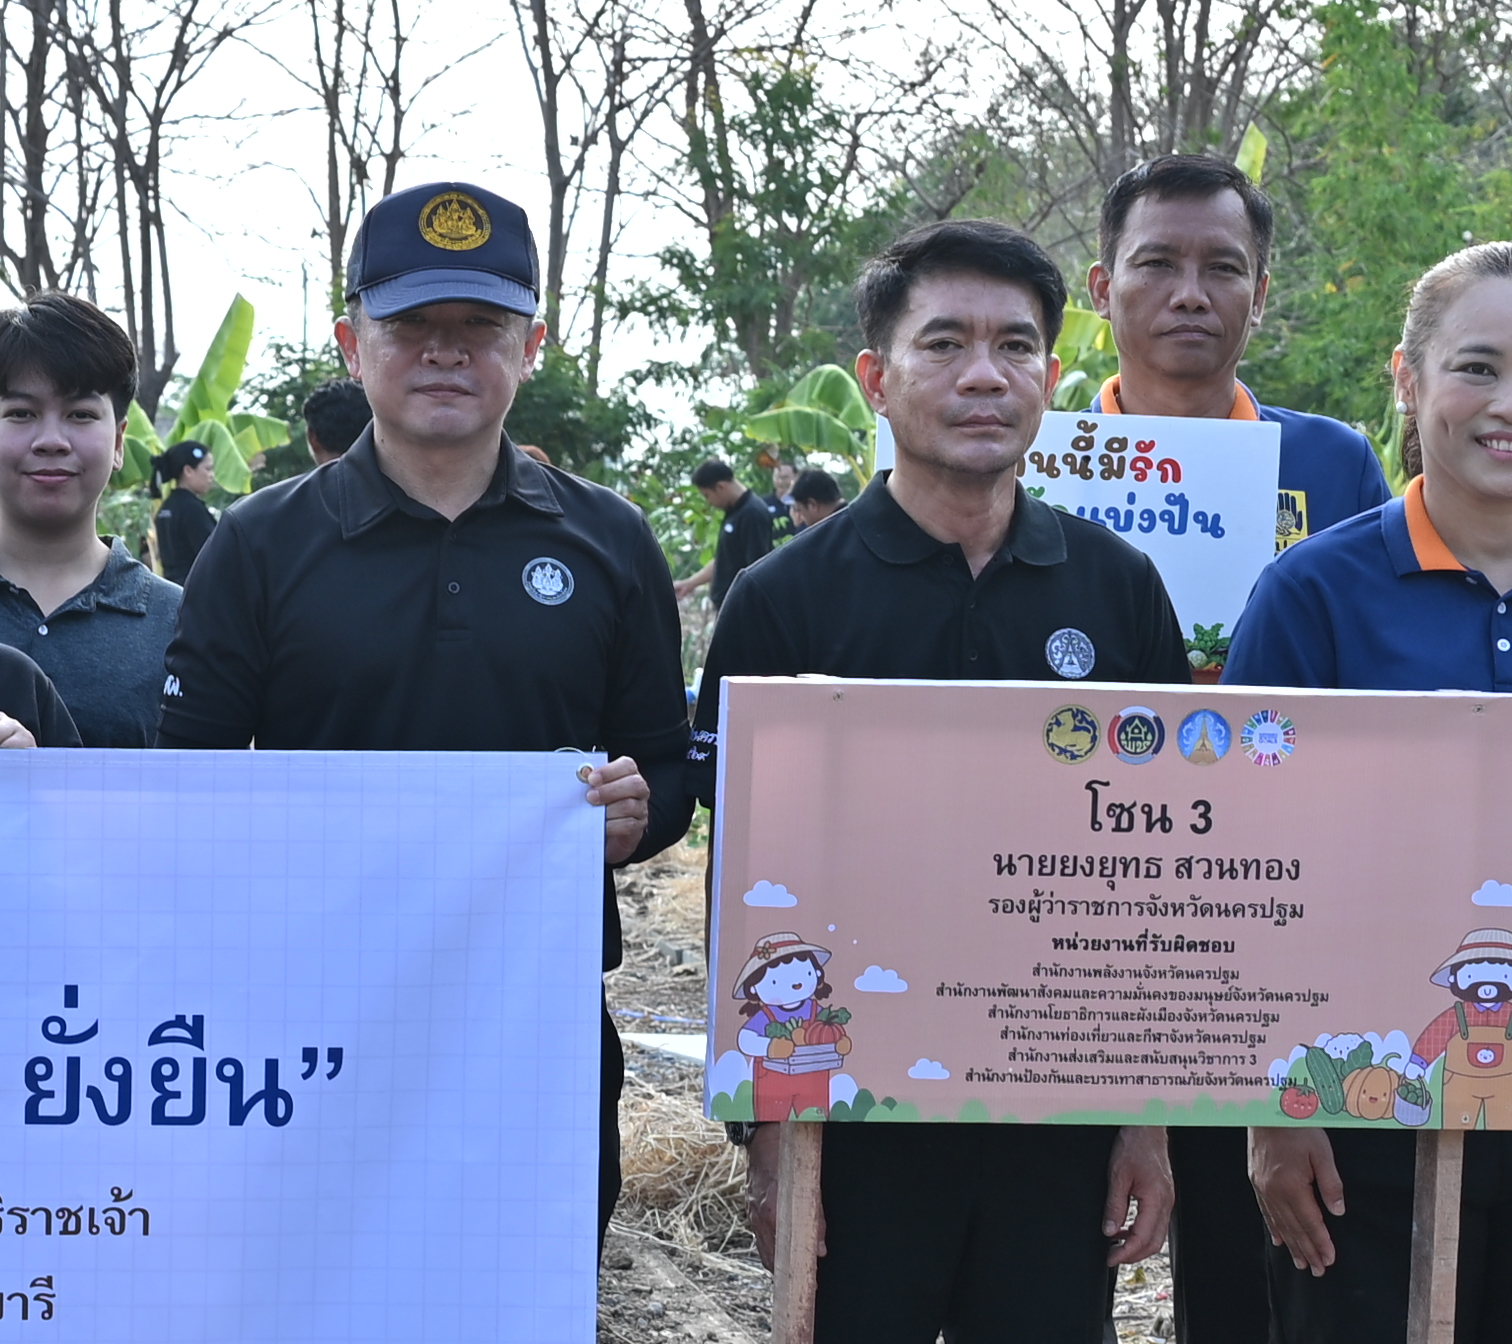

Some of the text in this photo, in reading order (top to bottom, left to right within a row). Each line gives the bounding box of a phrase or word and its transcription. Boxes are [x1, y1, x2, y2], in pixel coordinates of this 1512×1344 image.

[1085, 780, 1213, 835] โซน 3
[993, 853, 1300, 891] นายยงยุทธ สวนทอง
[988, 890, 1304, 926] รองผู้ว่าราชการจังหวัดนครปฐม
[1052, 928, 1235, 954] หน่วยงานที่รับผิดชอบ
[1032, 962, 1240, 984] สำนักงานพลังงานจังหวัดนครปฐม
[24, 984, 344, 1128] ยั่งยืน”
[1249, 1055, 1257, 1066] 3
